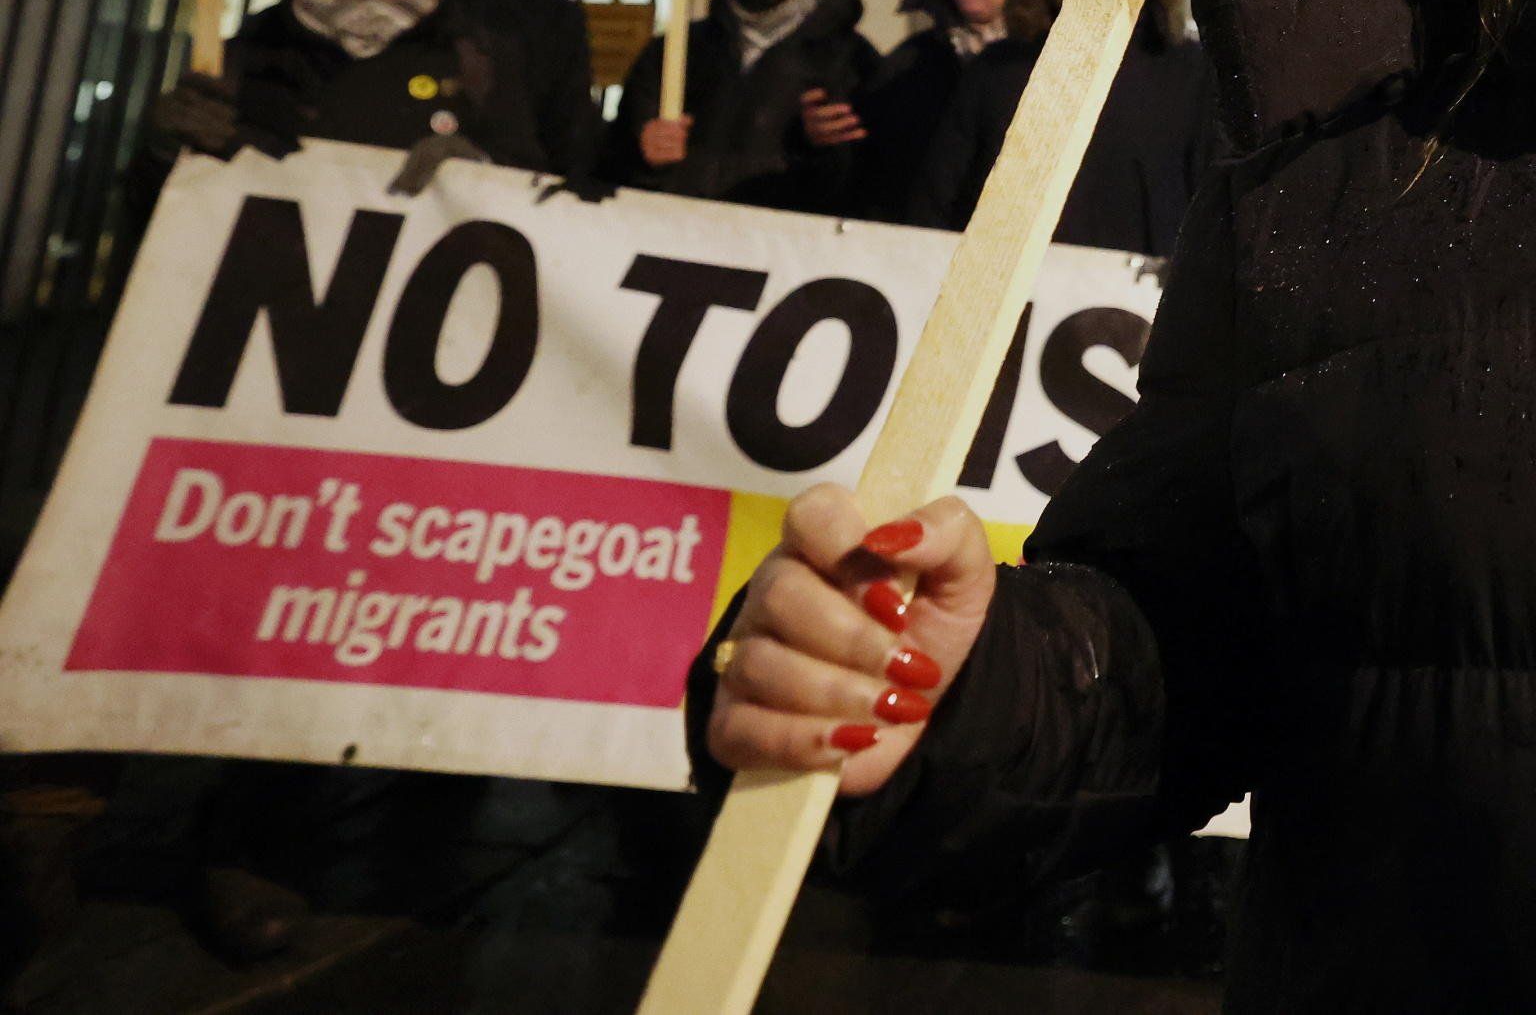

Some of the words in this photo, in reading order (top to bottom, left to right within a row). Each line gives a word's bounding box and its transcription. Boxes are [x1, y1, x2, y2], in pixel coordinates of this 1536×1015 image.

[166, 194, 540, 430] NO
[619, 253, 899, 473] TO
[154, 468, 363, 553] Don't
[369, 499, 702, 590] scapegoat
[256, 570, 569, 667] migrants
